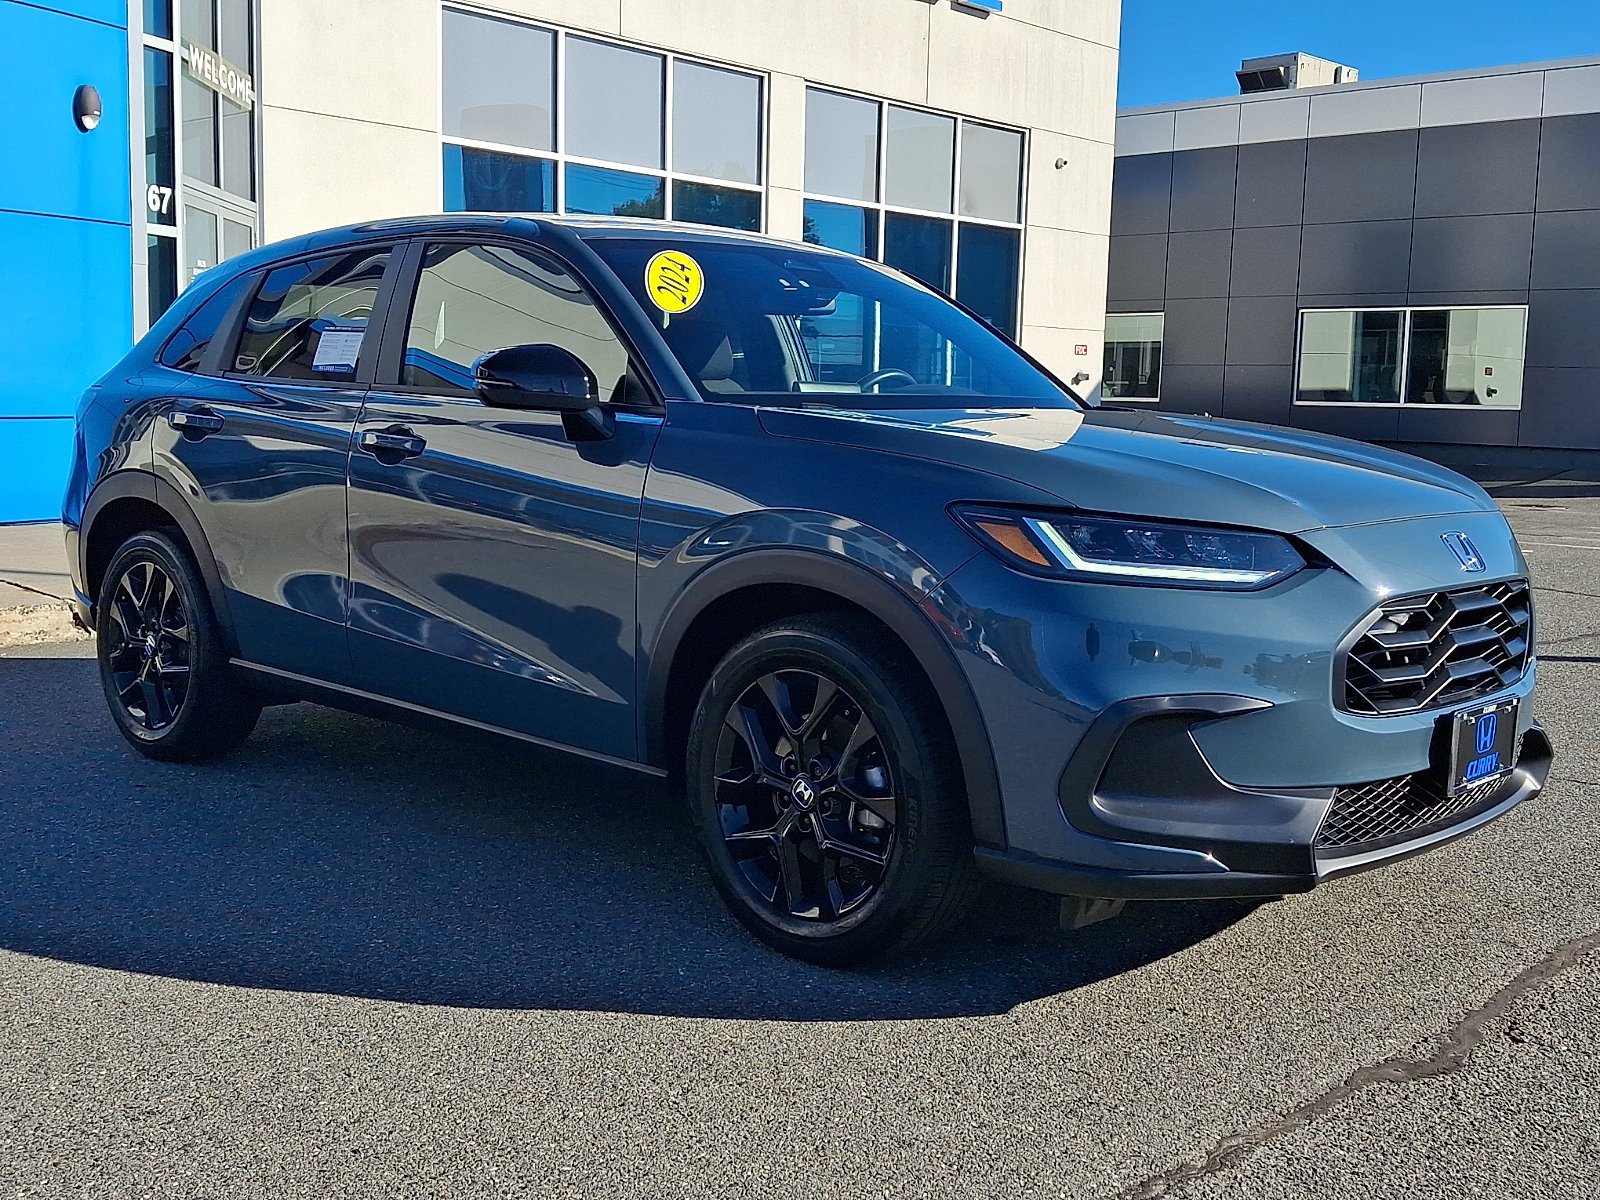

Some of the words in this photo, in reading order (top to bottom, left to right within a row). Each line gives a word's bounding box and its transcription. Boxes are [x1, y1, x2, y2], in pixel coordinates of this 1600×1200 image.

[189, 43, 252, 106] WELCOME
[145, 184, 172, 214] 67
[657, 256, 691, 305] 2024
[1466, 751, 1499, 780] CURRY
